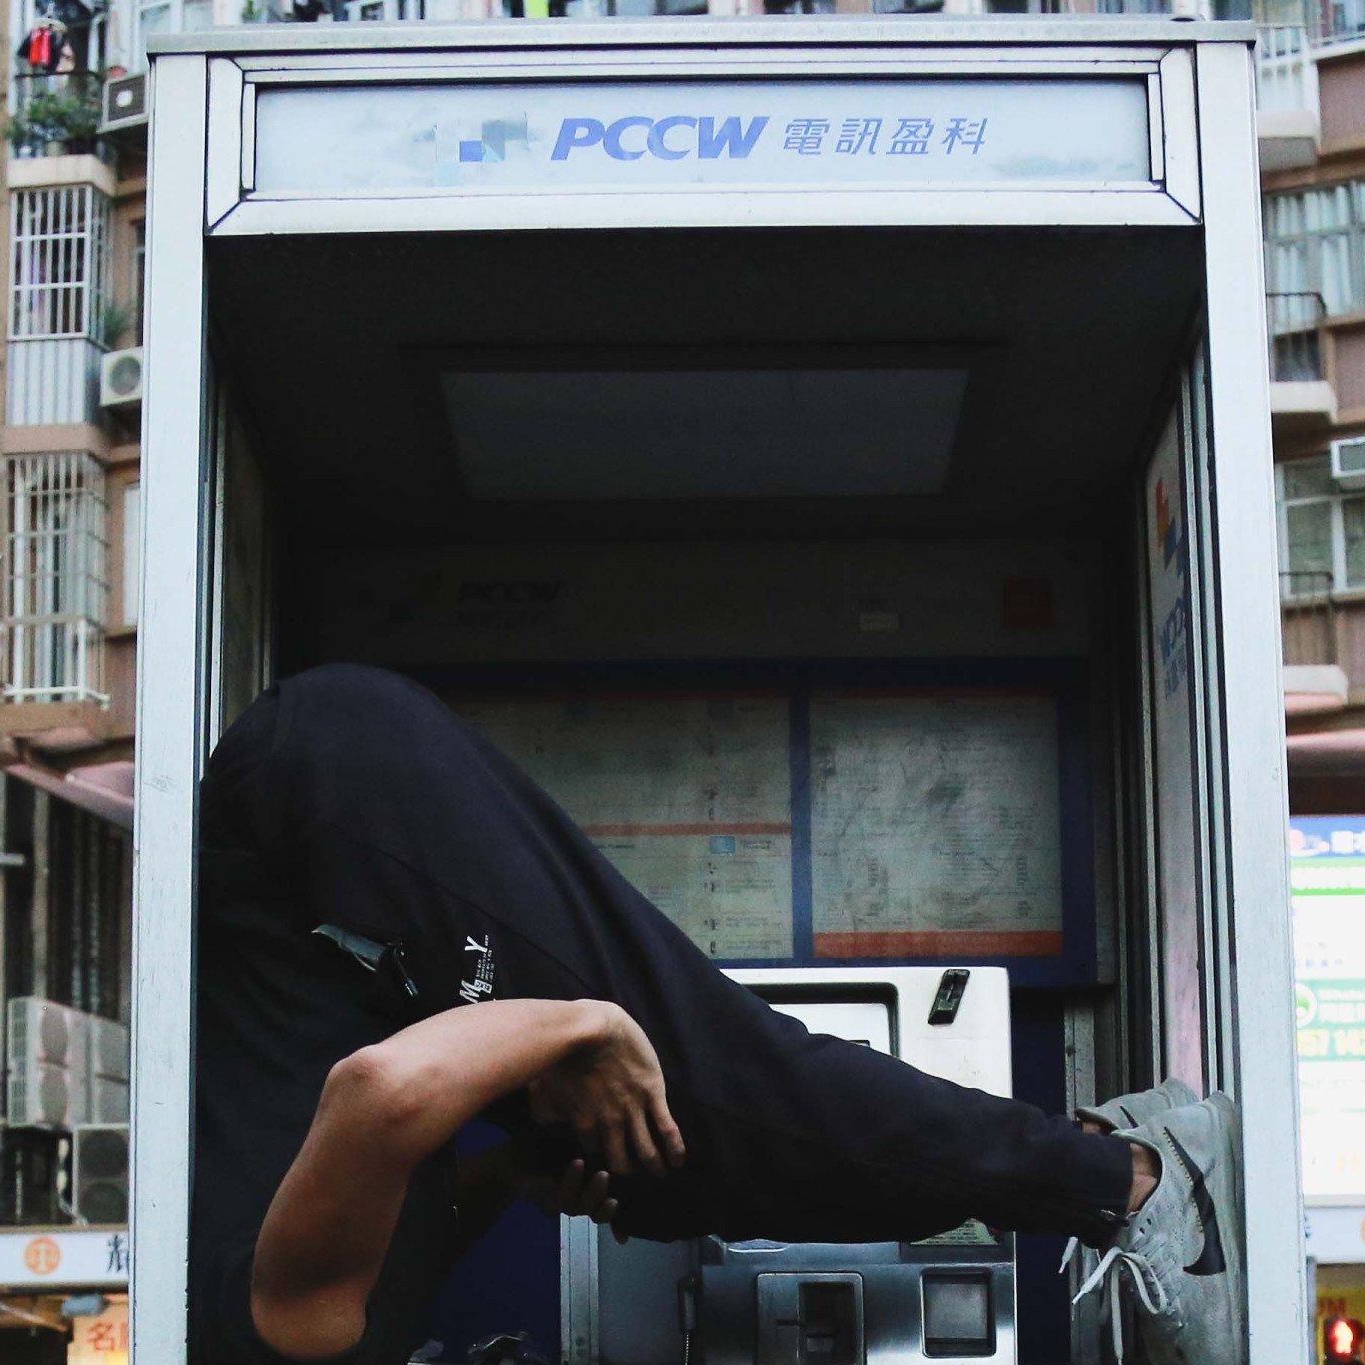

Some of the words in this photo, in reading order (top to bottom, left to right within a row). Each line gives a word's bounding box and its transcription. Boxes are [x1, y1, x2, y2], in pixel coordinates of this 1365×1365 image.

[550, 116, 770, 162] PCCW
[782, 117, 989, 156] 電訊盈科
